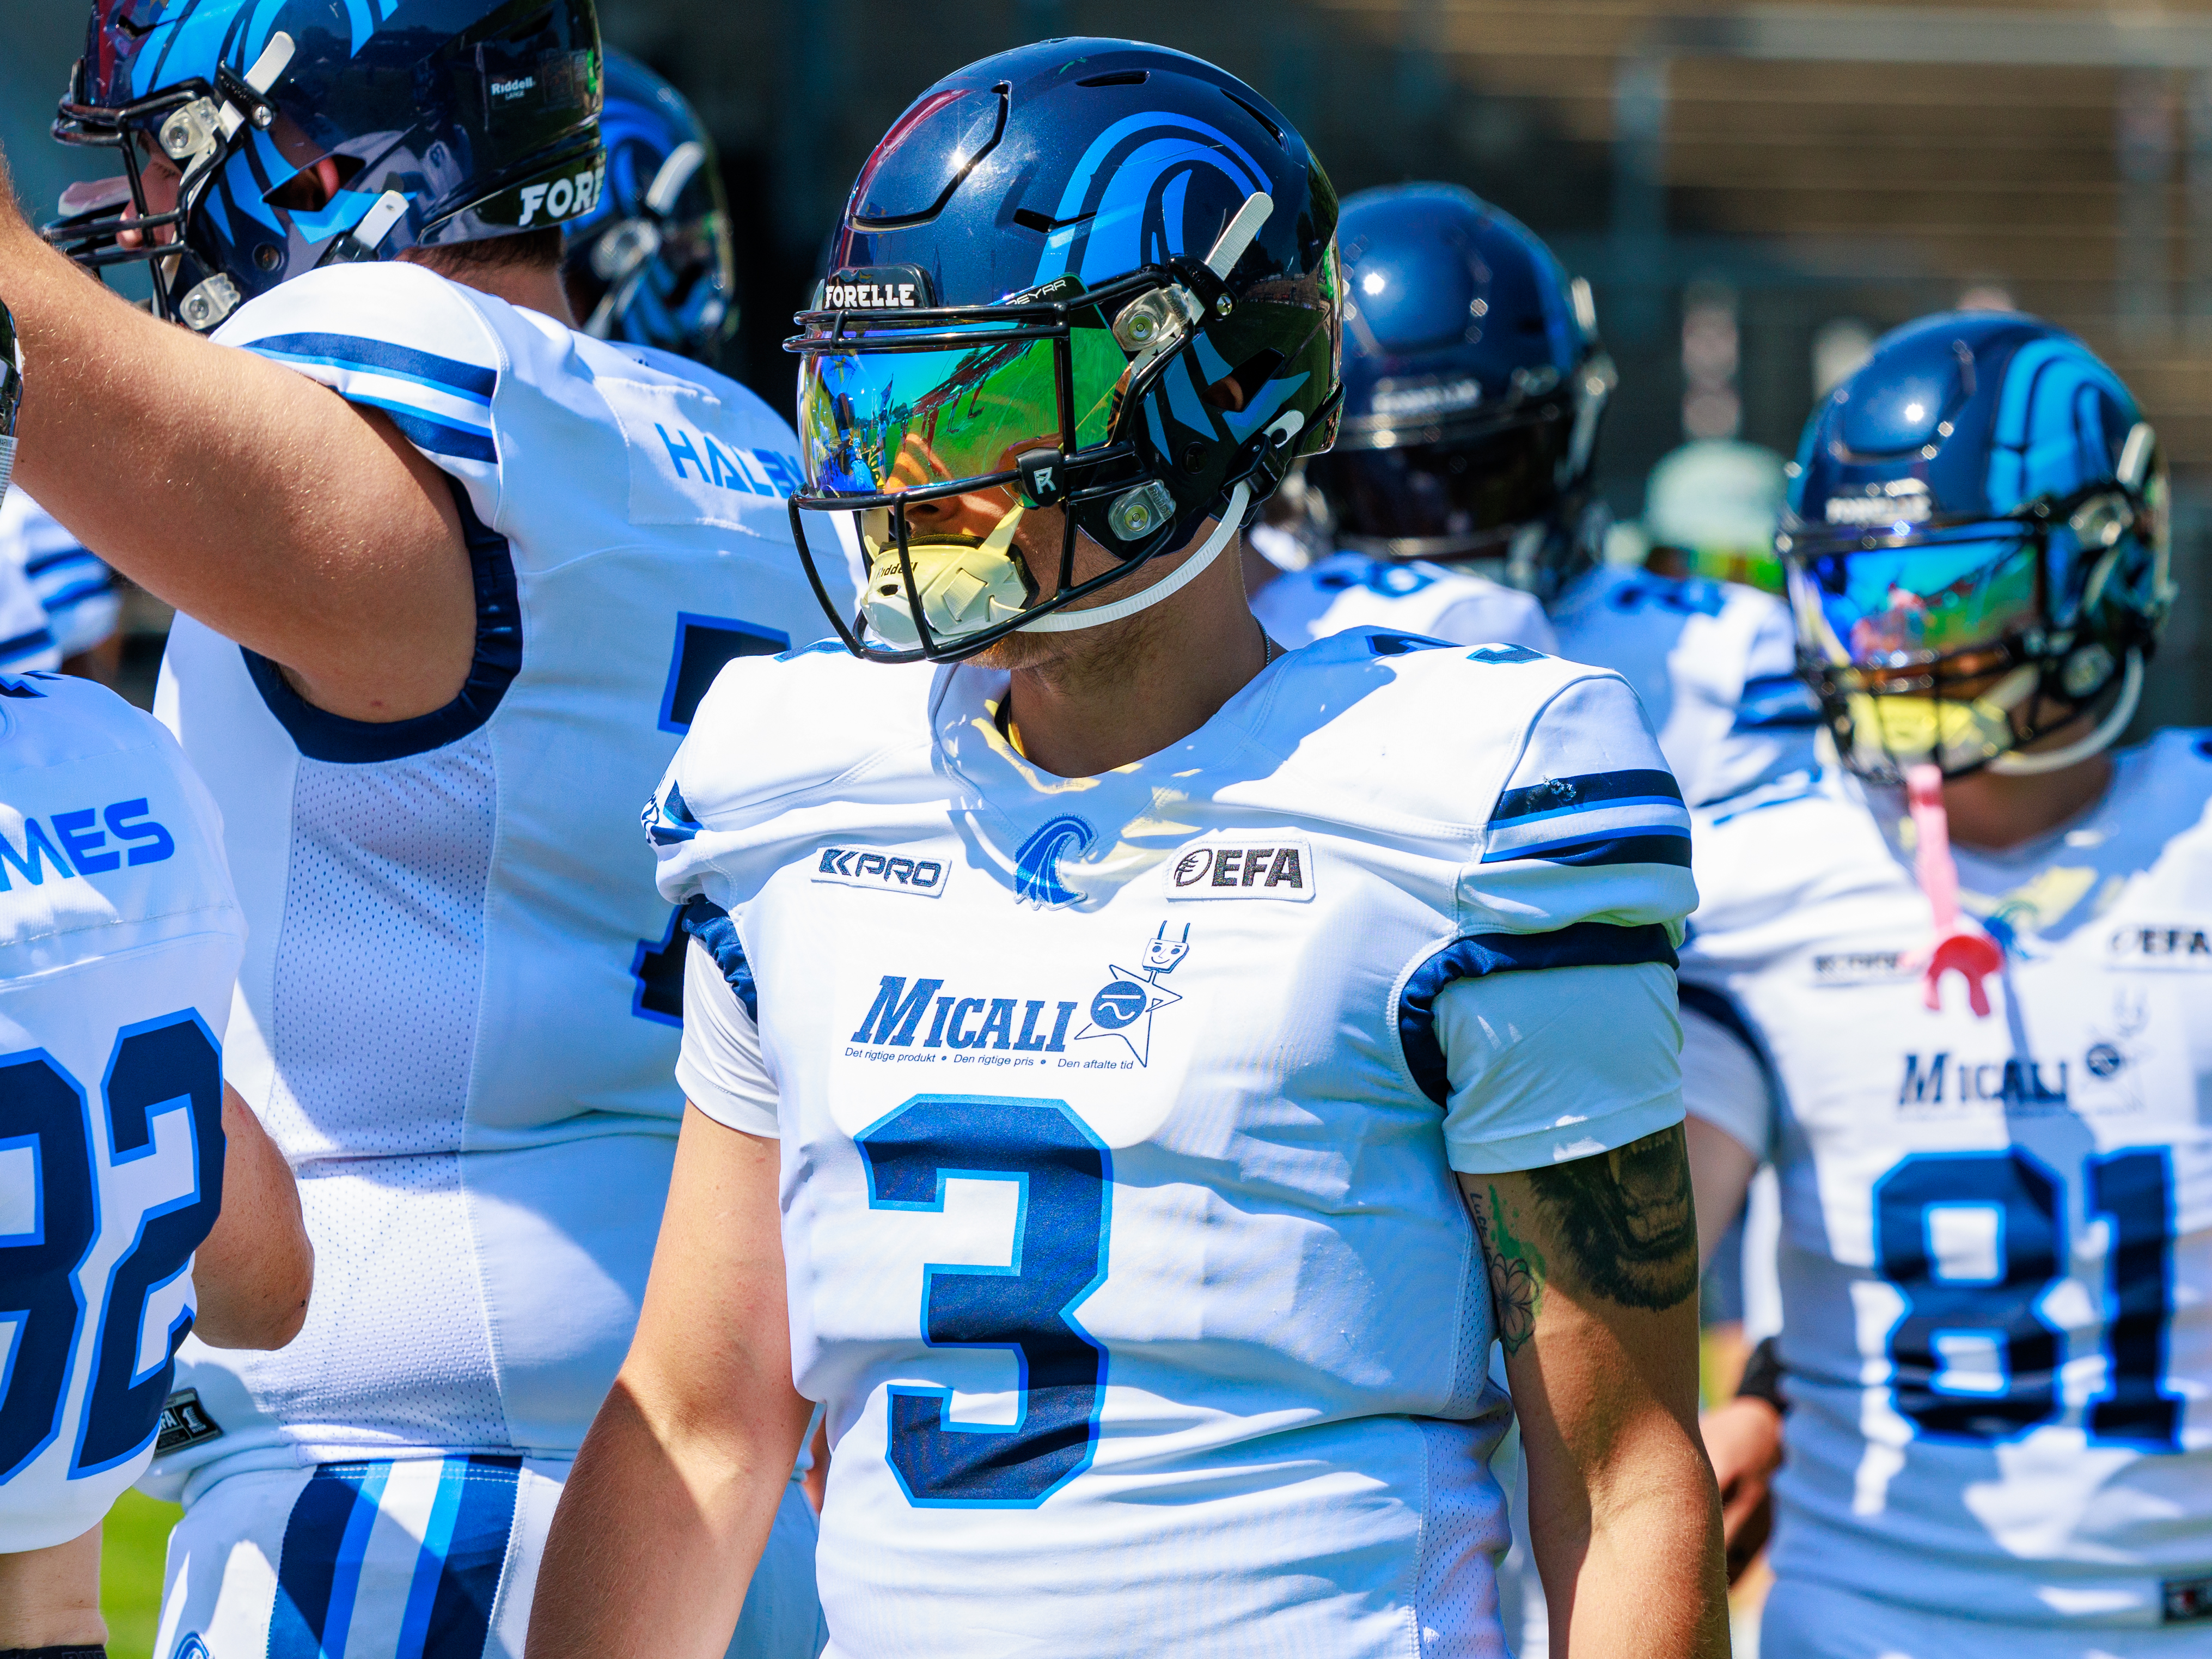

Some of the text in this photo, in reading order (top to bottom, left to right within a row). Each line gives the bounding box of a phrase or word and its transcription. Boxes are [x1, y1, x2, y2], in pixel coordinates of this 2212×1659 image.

[492, 76, 534, 96] Riddell
[824, 284, 914, 309] FORELLE
[819, 849, 941, 887] KPRO
[1212, 848, 1303, 888] EFA
[845, 1047, 1134, 1069] Det rigtige produkt Den rigtige pris Den aftalte tid
[853, 1093, 1114, 1510] 3
[1872, 1144, 2185, 1454] 81
